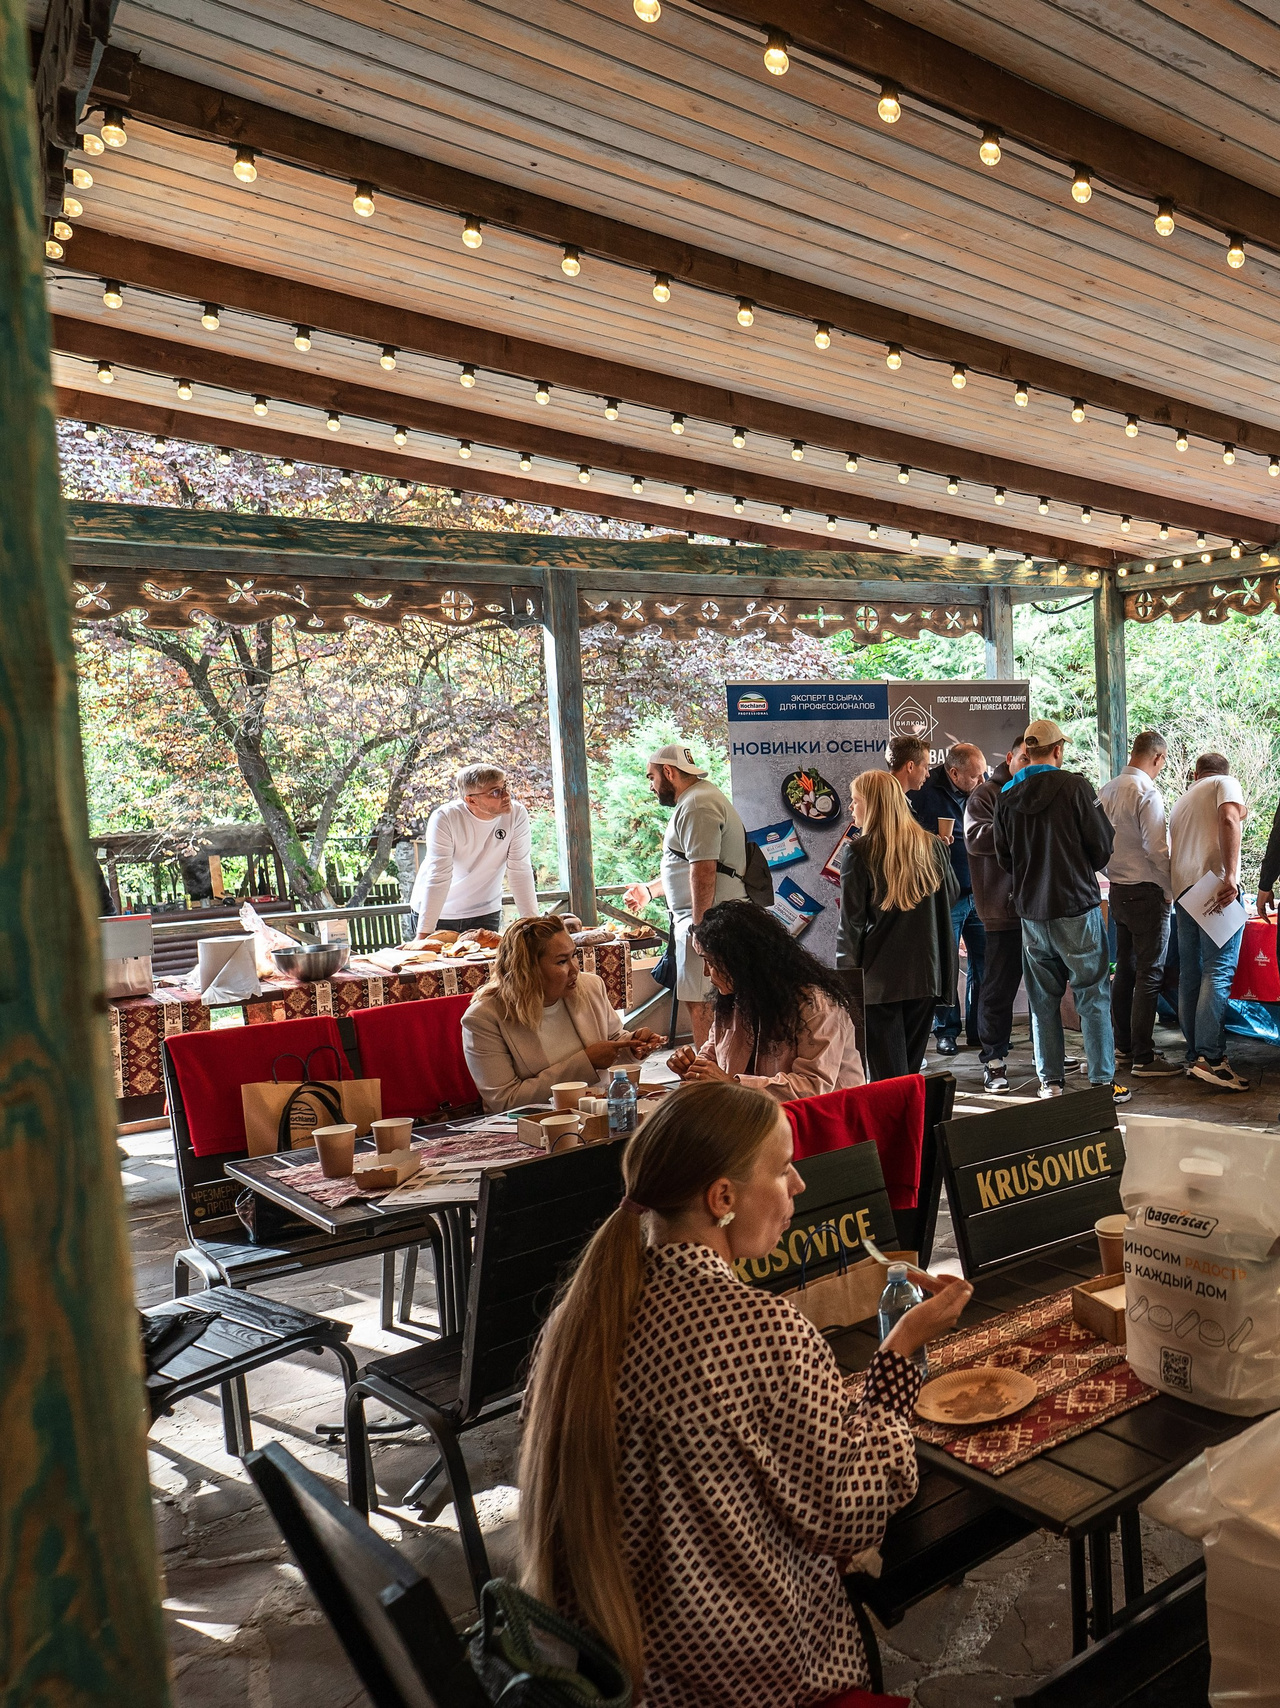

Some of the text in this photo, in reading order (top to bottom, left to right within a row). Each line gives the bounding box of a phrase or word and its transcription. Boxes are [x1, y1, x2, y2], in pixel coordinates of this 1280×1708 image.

[779, 702, 875, 711] ДЛЯ ПРОФЕССИОНАЛОВ
[791, 694, 827, 702] ЭКСПЕРТ
[733, 739, 887, 755] НОВИНКИ ОСЕНИ
[976, 1142, 1112, 1209] KRUŠOVICE
[191, 1183, 243, 1204] ЧРЕЗМЕРНО
[1148, 1207, 1210, 1231] bagerstat
[1124, 1241, 1247, 1281] ИНОСИМ РАДОСТЬ
[1124, 1261, 1227, 1301] В КАЖДЫЙ ДОМ
